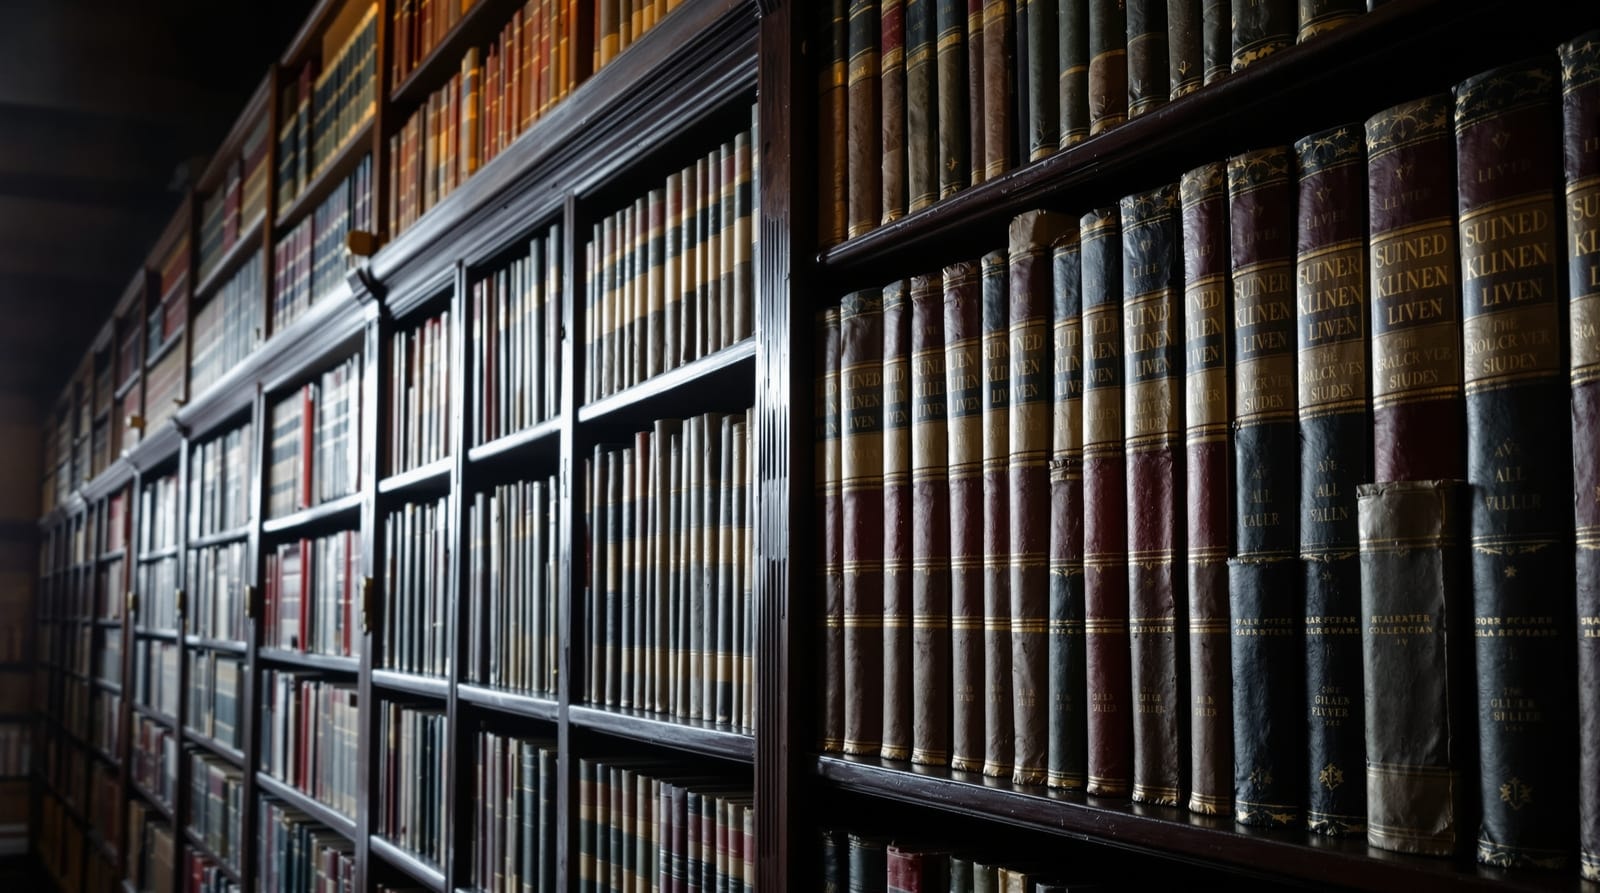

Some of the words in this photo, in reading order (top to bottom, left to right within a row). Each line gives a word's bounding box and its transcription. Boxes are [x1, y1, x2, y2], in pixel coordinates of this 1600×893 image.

[1464, 207, 1549, 248] SUINED
[1466, 241, 1549, 282] KLINEN
[1376, 265, 1449, 300] KLINEN
[1481, 277, 1545, 308] LIVEN
[1387, 297, 1444, 326] LIVEN
[1316, 482, 1341, 498] ALL
